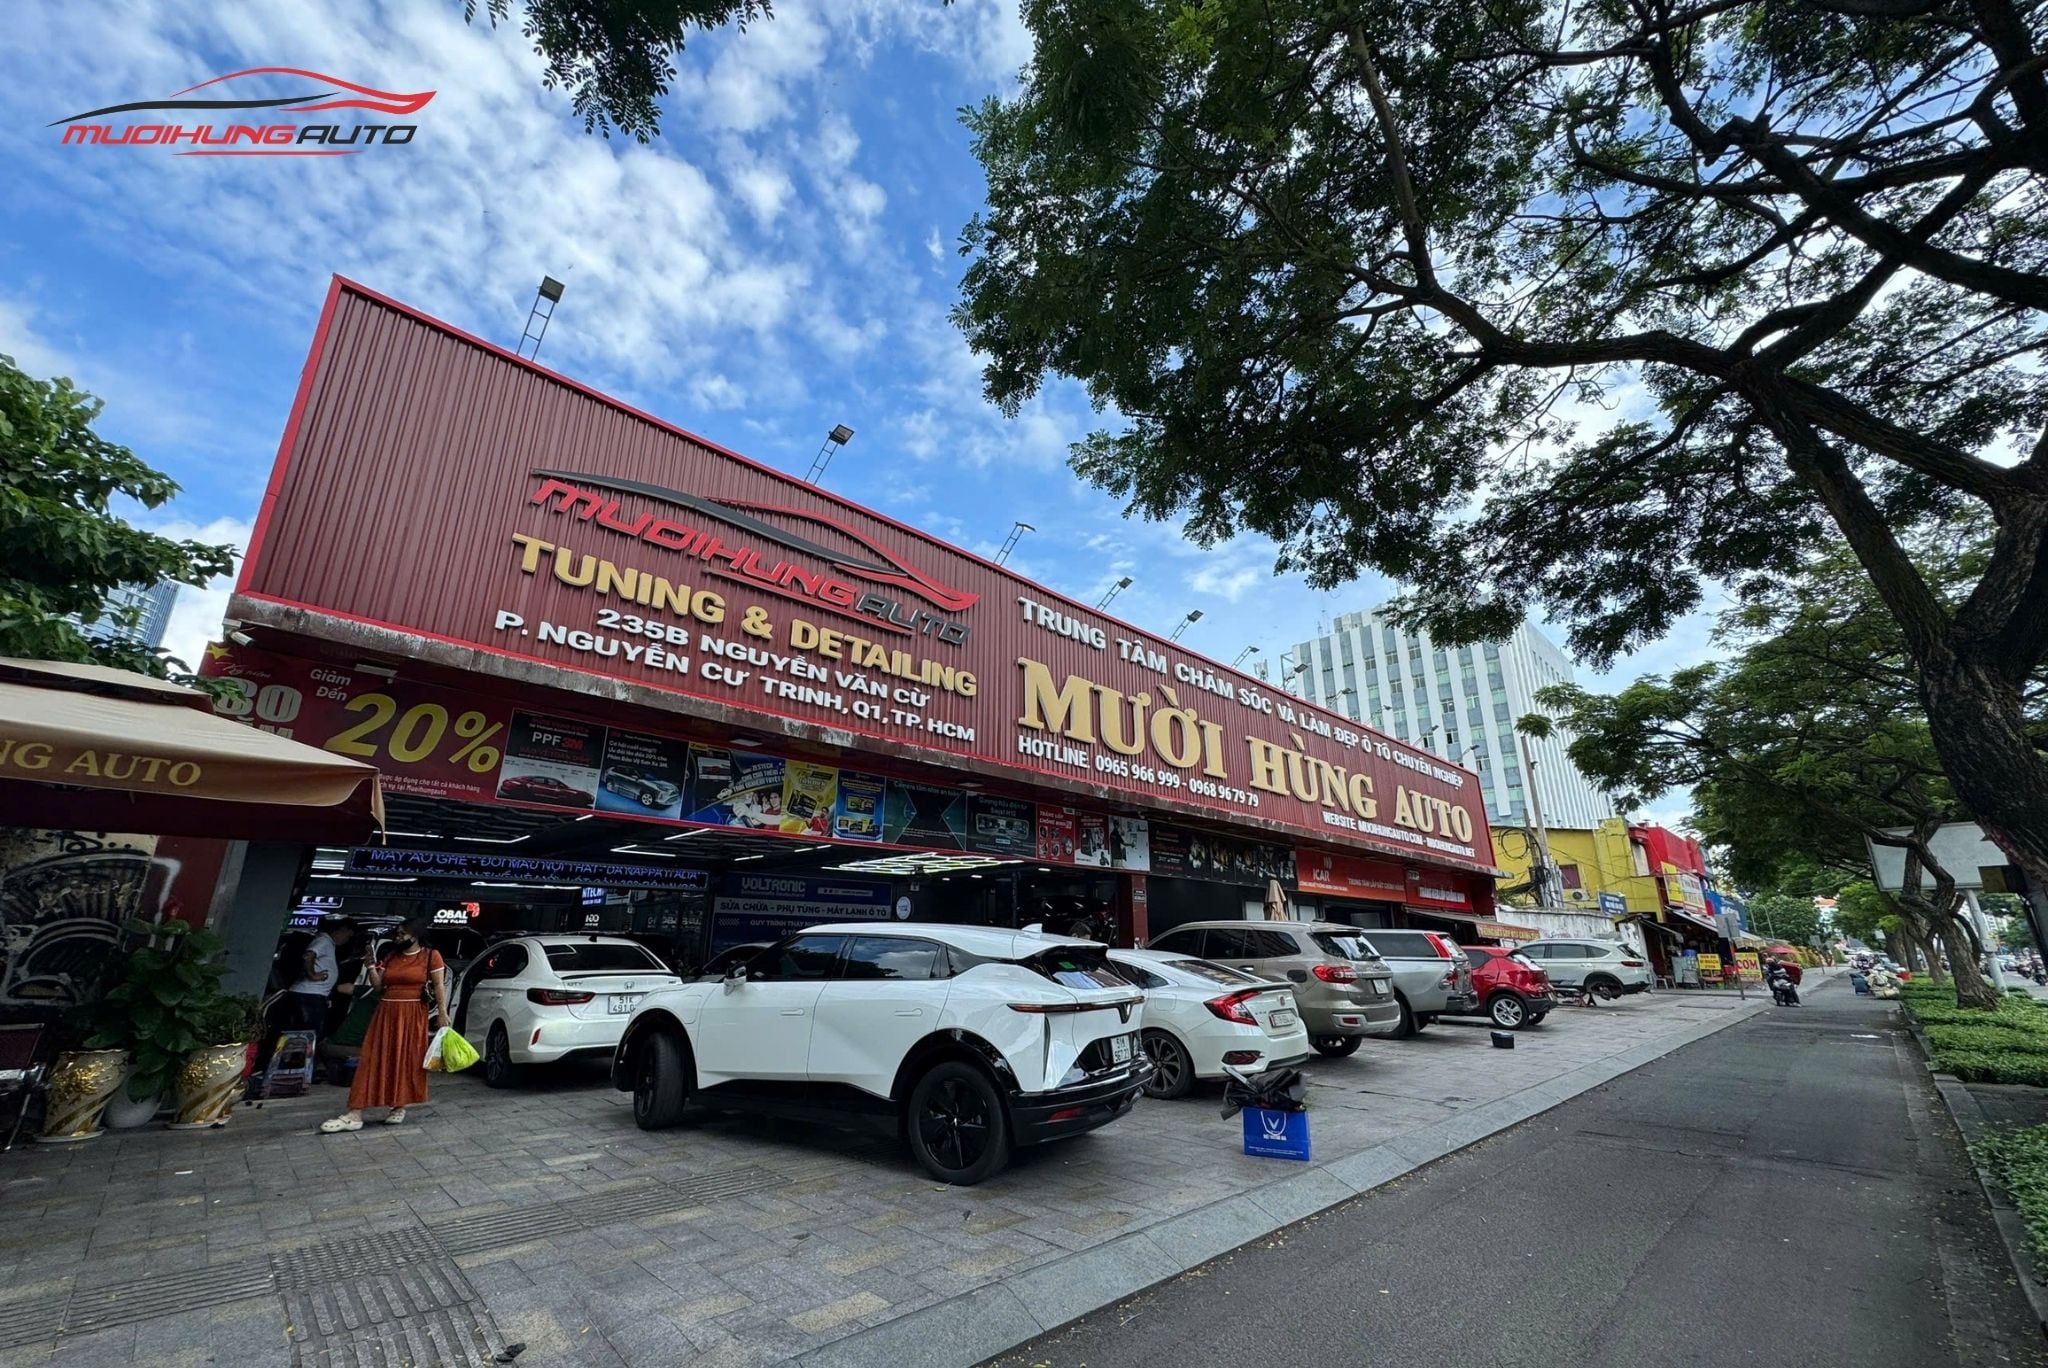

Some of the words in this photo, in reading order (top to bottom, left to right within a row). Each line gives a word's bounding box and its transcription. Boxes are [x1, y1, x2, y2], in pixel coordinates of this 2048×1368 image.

[511, 532, 727, 624] TUNING
[740, 605, 773, 640] &
[790, 618, 978, 697] DETAILING
[310, 667, 351, 686] Giảm
[494, 610, 528, 637] P.
[537, 621, 690, 675] NGUYỄN
[700, 660, 750, 688] CƯ
[927, 717, 975, 742] HCM
[597, 608, 689, 647] 235B
[700, 633, 827, 686] NGUYỄN
[834, 670, 888, 699] VĂN
[893, 686, 931, 708] CỪ
[316, 685, 348, 702] Đến
[1017, 596, 1107, 650] TRUNG
[1115, 639, 1168, 675] TÂM
[1174, 662, 1234, 700] CHĂM
[1237, 686, 1272, 715] SÓC
[1276, 701, 1297, 725] VÀ
[1298, 711, 1331, 738] LÀM
[1333, 726, 1359, 750] ĐẸP
[1361, 734, 1372, 753] Ô
[1373, 741, 1391, 762] TÔ
[1392, 749, 1433, 777] CHUYÊN
[323, 692, 504, 774] 20%
[531, 731, 562, 746] PPF
[1016, 657, 1228, 780] MƯỜI
[1246, 732, 1378, 819] HÙNG
[1394, 785, 1474, 843] AUTO
[64, 749, 202, 787] AUTO
[1095, 754, 1129, 778] 0965
[1131, 763, 1156, 783] 966
[1158, 769, 1181, 789] 999
[1189, 778, 1217, 798] 0968
[741, 876, 806, 894] VOLTRONIC
[1312, 868, 1330, 882] ICAR
[720, 899, 740, 911] SỬA
[776, 904, 795, 915] PHỤ
